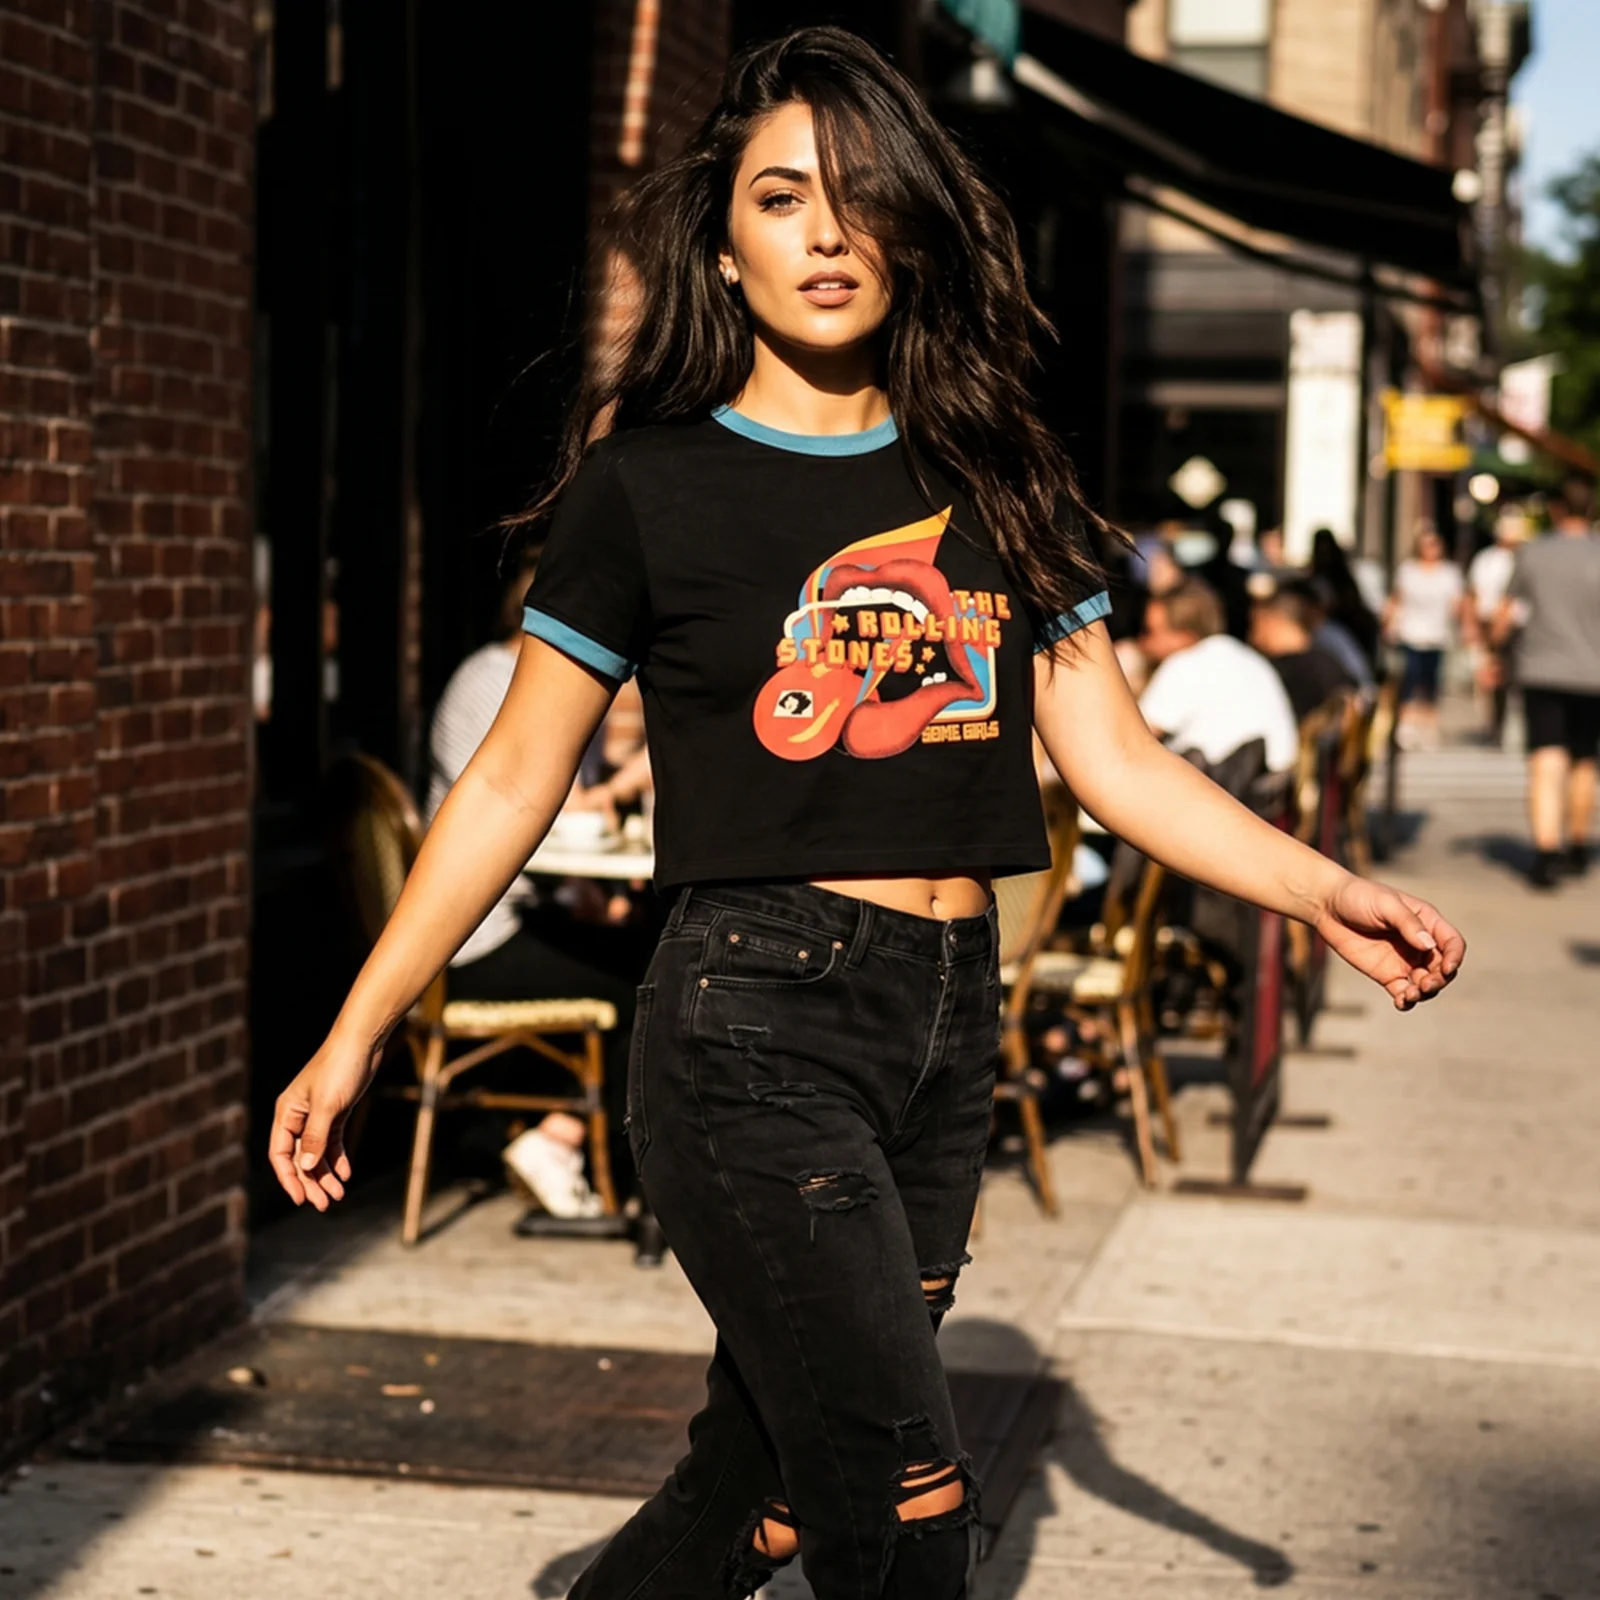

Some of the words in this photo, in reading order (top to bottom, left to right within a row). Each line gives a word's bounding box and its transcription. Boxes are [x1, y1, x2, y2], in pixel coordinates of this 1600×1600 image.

[954, 590, 1011, 620] THE
[857, 610, 1001, 647] ROLLING
[776, 637, 914, 673] STONES
[921, 724, 961, 743] SOME
[963, 721, 999, 740] GIRLS
